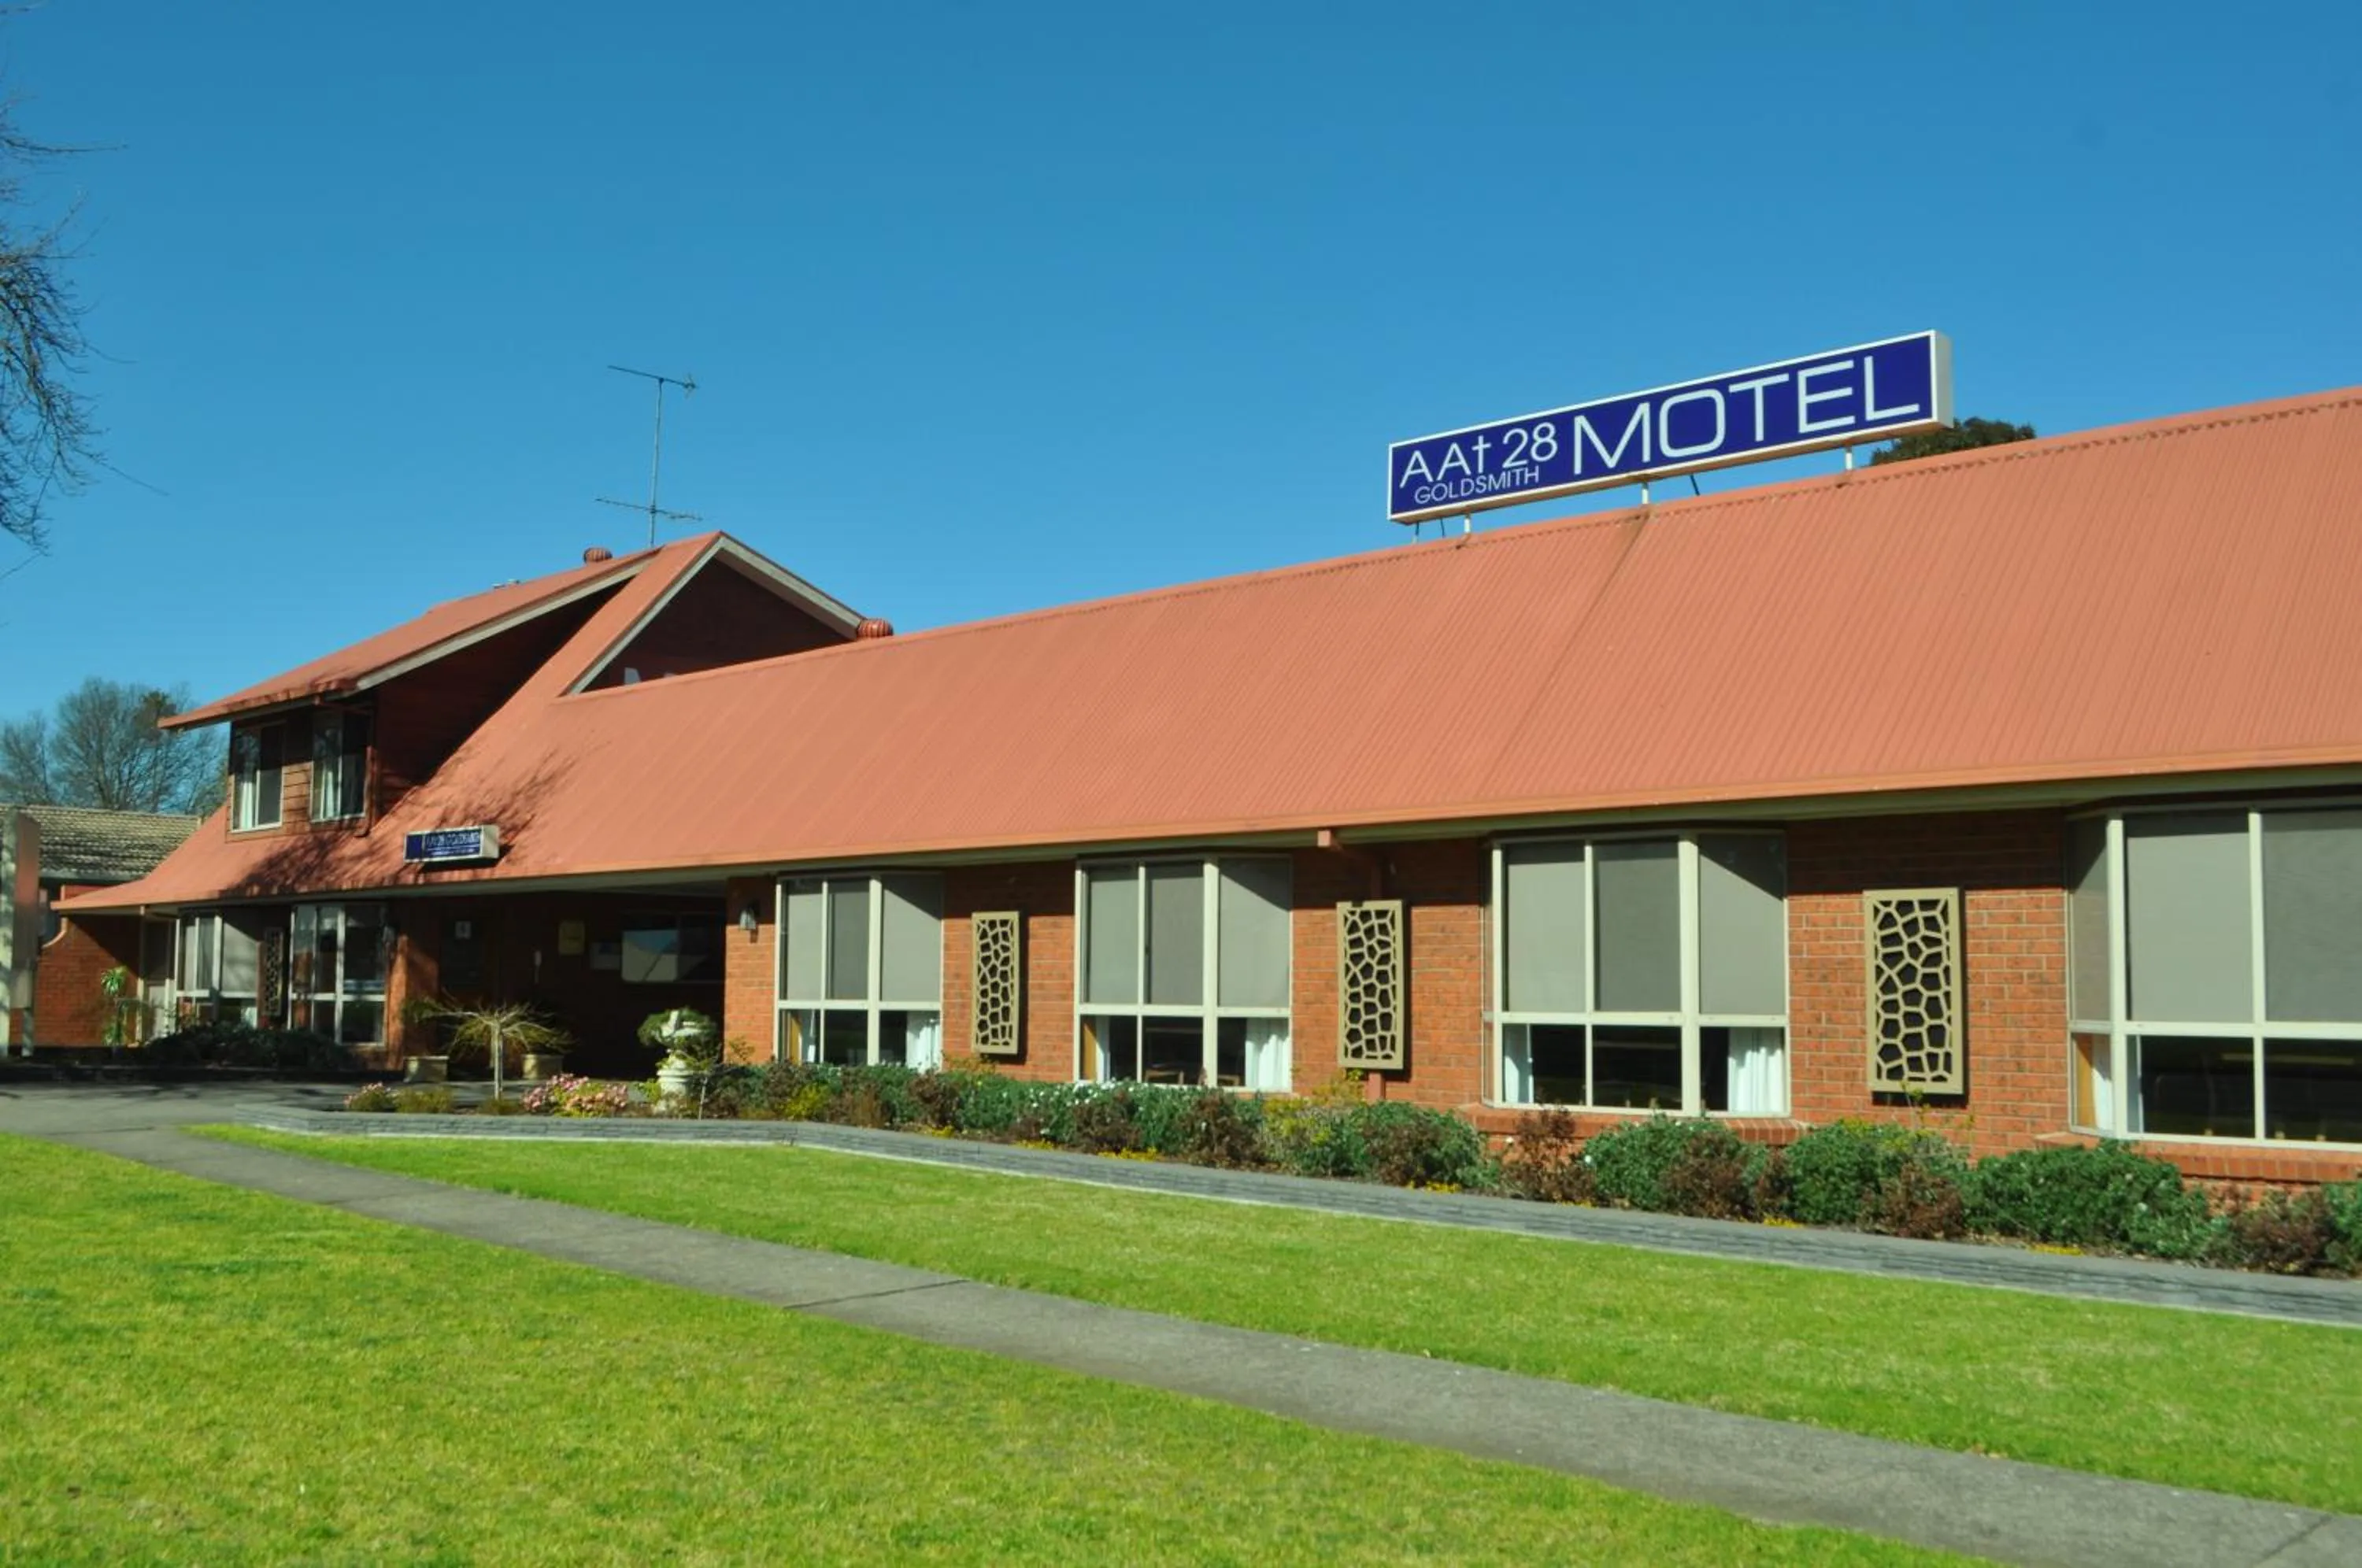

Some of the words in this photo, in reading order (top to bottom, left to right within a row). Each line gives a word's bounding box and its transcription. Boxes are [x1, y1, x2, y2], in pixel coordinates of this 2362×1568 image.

[1574, 355, 1920, 475] MOTEL
[1501, 422, 1558, 468] 28
[1414, 465, 1539, 505] GOLDSMITH
